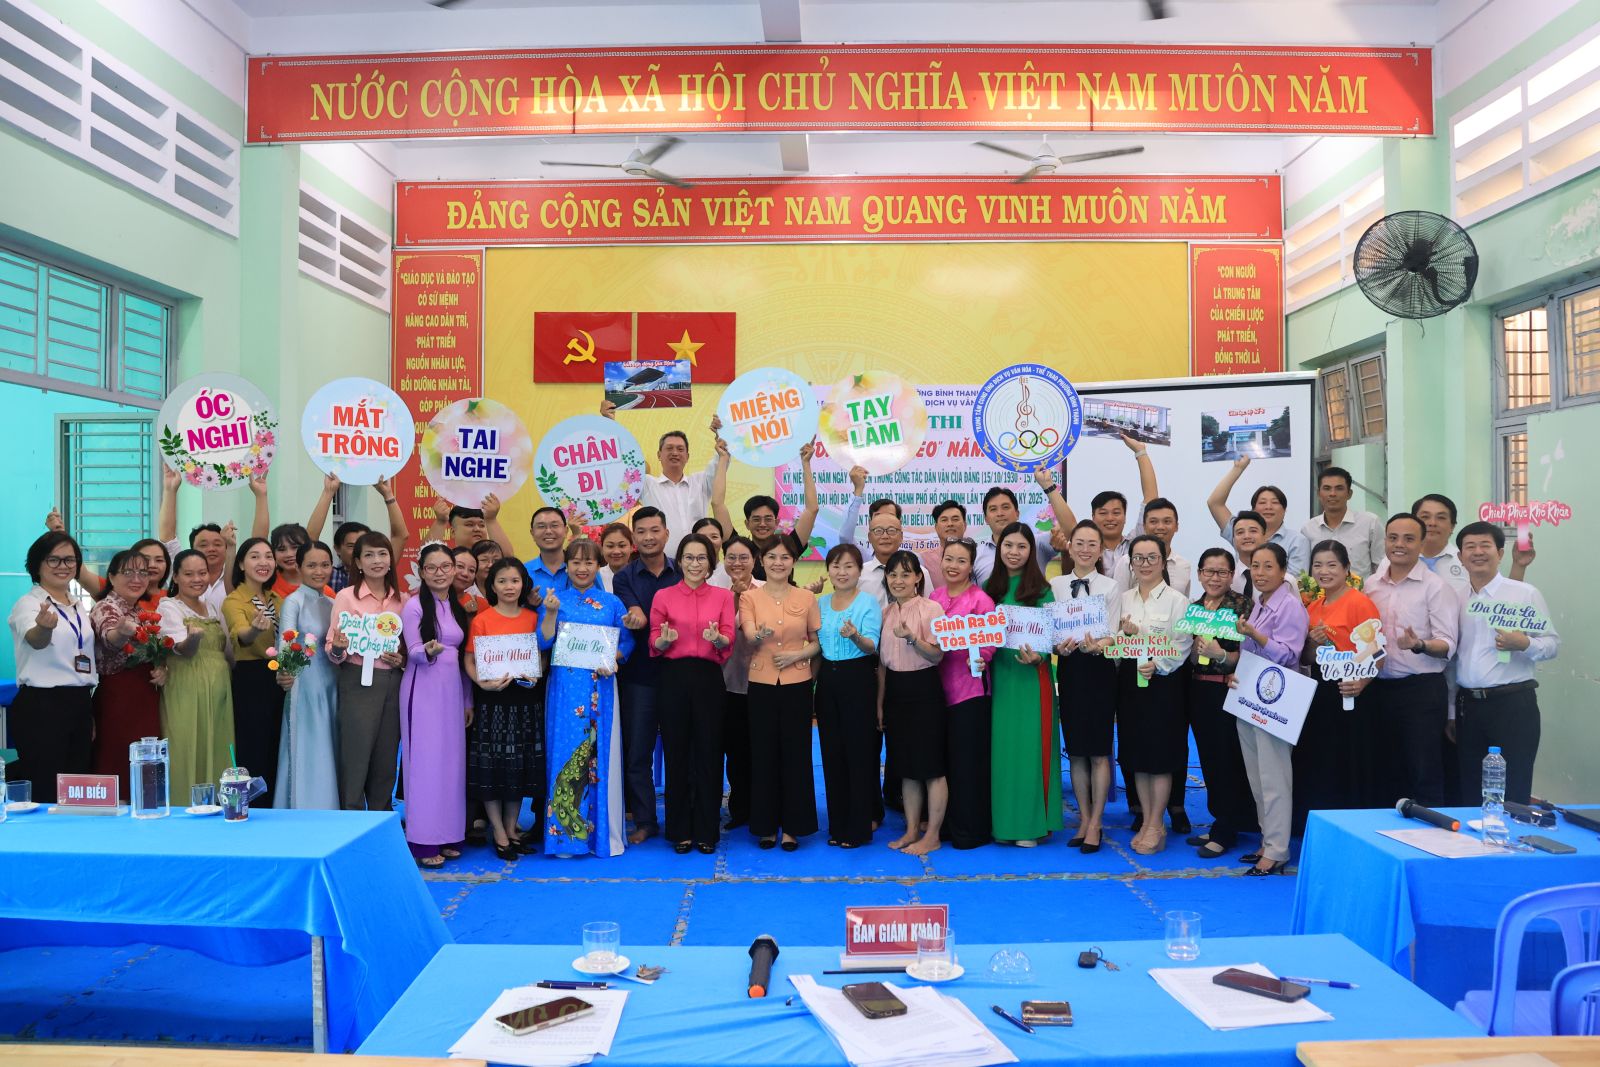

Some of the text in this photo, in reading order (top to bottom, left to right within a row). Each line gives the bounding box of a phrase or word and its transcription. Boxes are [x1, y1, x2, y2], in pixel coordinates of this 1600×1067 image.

[310, 54, 1369, 127] NƯỚC CỘNG HÒA XÃ HỘI CHỦ NGHĨA VIỆT NAM MUÔN NĂM
[446, 186, 1228, 236] ĐẢNG CỘNG SẢN VIỆT NAM QUANG VINH MUÔN NĂM
[420, 272, 434, 289] DỤC
[436, 269, 445, 285] VÀ
[446, 269, 460, 285] ĐÀO
[461, 271, 475, 289] TẠO
[1235, 262, 1256, 279] NGƯỜI
[417, 291, 458, 309] CÓ SỨ MỆNH
[1213, 284, 1261, 300] LÀ TRUNG TÂM
[405, 312, 424, 327] NÂNG
[425, 315, 439, 327] CAO
[440, 312, 454, 327] DÂN
[1210, 304, 1265, 325] CỦA CHIẾN LƯỢC
[416, 330, 456, 348] PHÁT TRIỂN
[1217, 327, 1234, 343] PHÁT
[406, 353, 429, 370] NGUỒN
[430, 355, 450, 370] NHÂN
[1215, 346, 1261, 364] ĐỒNG THỜI LÀ
[401, 374, 412, 391] BỒI
[413, 375, 437, 392] DƯỠNG
[438, 376, 457, 392] NHÂN
[935, 388, 954, 397] BÌNH
[195, 389, 231, 419] ÓC
[419, 397, 433, 413] GÓP
[730, 388, 800, 423] MIỆNG
[846, 396, 891, 423] TAY
[925, 399, 958, 408] DỊCH VỤ
[332, 399, 384, 429] MẮT
[928, 415, 962, 429] THI
[186, 415, 249, 451] NGHĨ
[458, 428, 496, 450] TAI
[750, 415, 789, 444] NÓI
[851, 421, 900, 449] LÀM
[317, 430, 399, 458] TRÔNG
[553, 436, 618, 468] CHÂN
[445, 456, 508, 479] NGHE
[818, 469, 832, 484] NĂM
[832, 469, 847, 484] NGÀY
[911, 469, 923, 484] TÁC
[924, 468, 937, 484] DÂN
[937, 468, 950, 486] VẬN
[950, 466, 962, 484] CỦA
[963, 467, 980, 484] ĐẢNG
[577, 470, 604, 494] ĐI
[782, 490, 798, 505] CHÀO
[1028, 493, 1043, 505] 2025
[413, 504, 422, 520] VÀ
[933, 608, 1007, 634] Sinh Ra Để
[969, 629, 1003, 646] Sáng
[1317, 646, 1354, 662] Team
[68, 781, 107, 801] ĐẠI BIỂU
[853, 918, 941, 943] BAN GIÁM KHẢO
